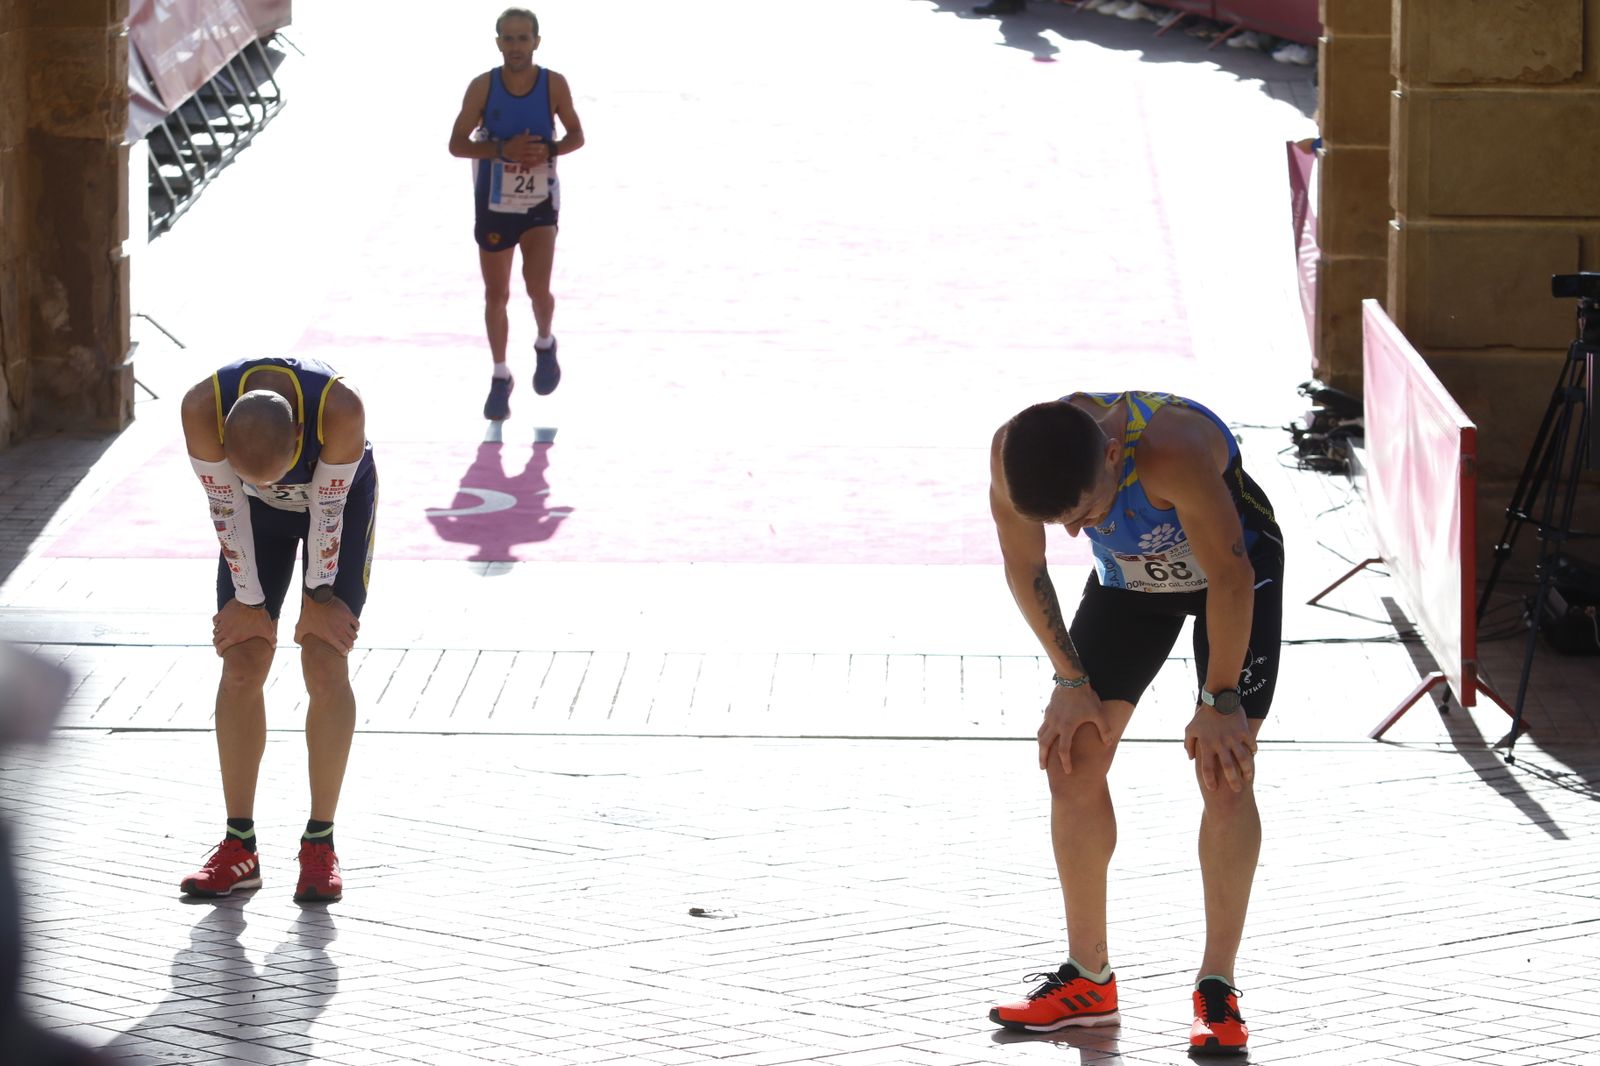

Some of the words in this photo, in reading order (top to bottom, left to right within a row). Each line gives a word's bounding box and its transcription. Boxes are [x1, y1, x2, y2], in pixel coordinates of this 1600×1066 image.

[514, 175, 535, 193] 24
[1145, 561, 1193, 581] 68
[1126, 580, 1167, 590] DOMINGO
